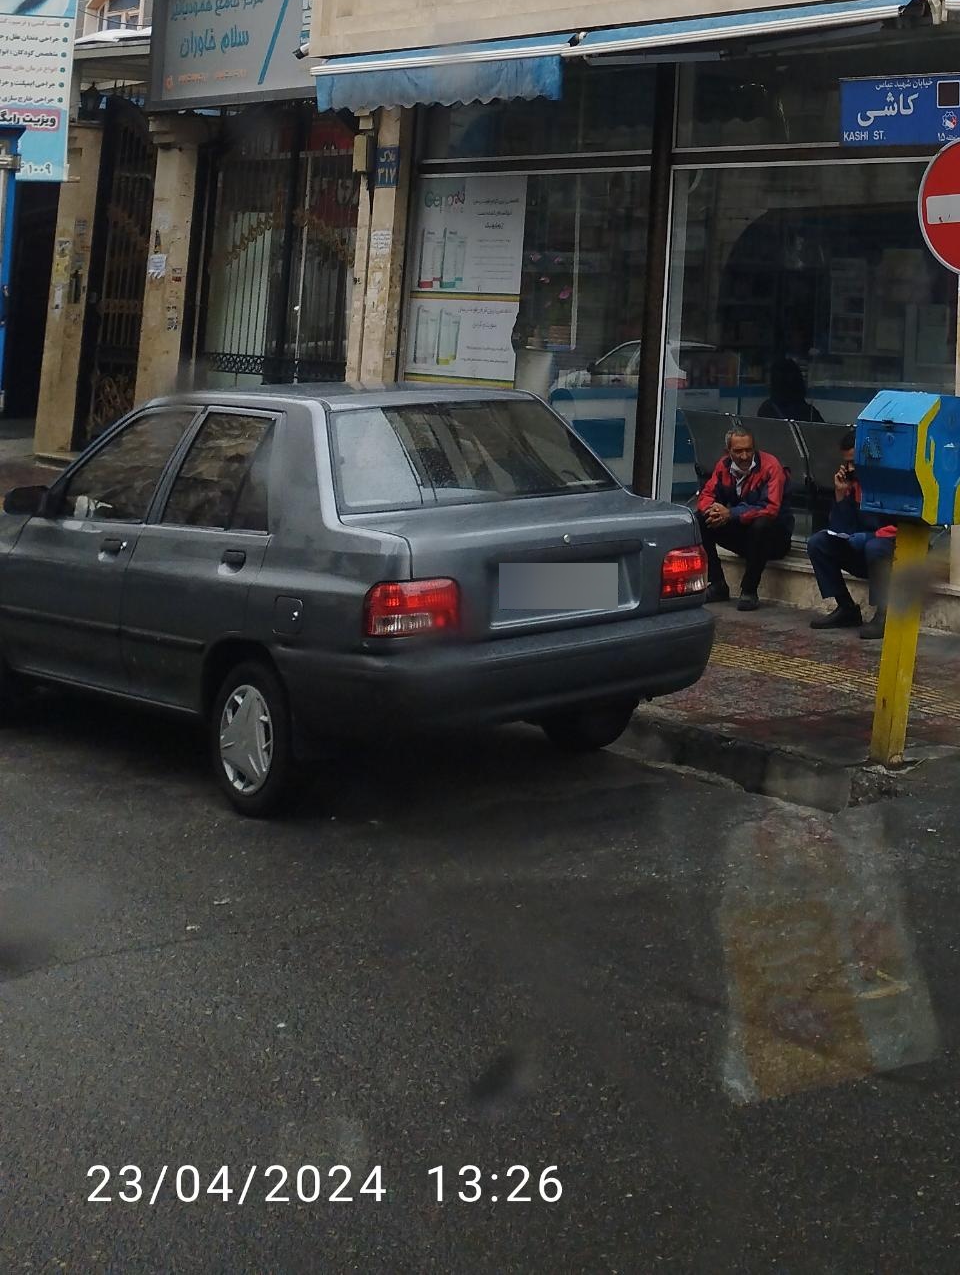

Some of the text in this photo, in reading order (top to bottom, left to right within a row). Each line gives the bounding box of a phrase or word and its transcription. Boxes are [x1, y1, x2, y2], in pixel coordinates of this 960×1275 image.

[180, 25, 249, 58] سلام خاوران
[894, 79, 912, 90] شهید
[912, 78, 934, 89] خیابان
[857, 92, 919, 127] کاشی
[22, 114, 57, 127] ویزیت
[843, 130, 887, 142] KASHI ST.
[938, 132, 946, 142] ۱۵
